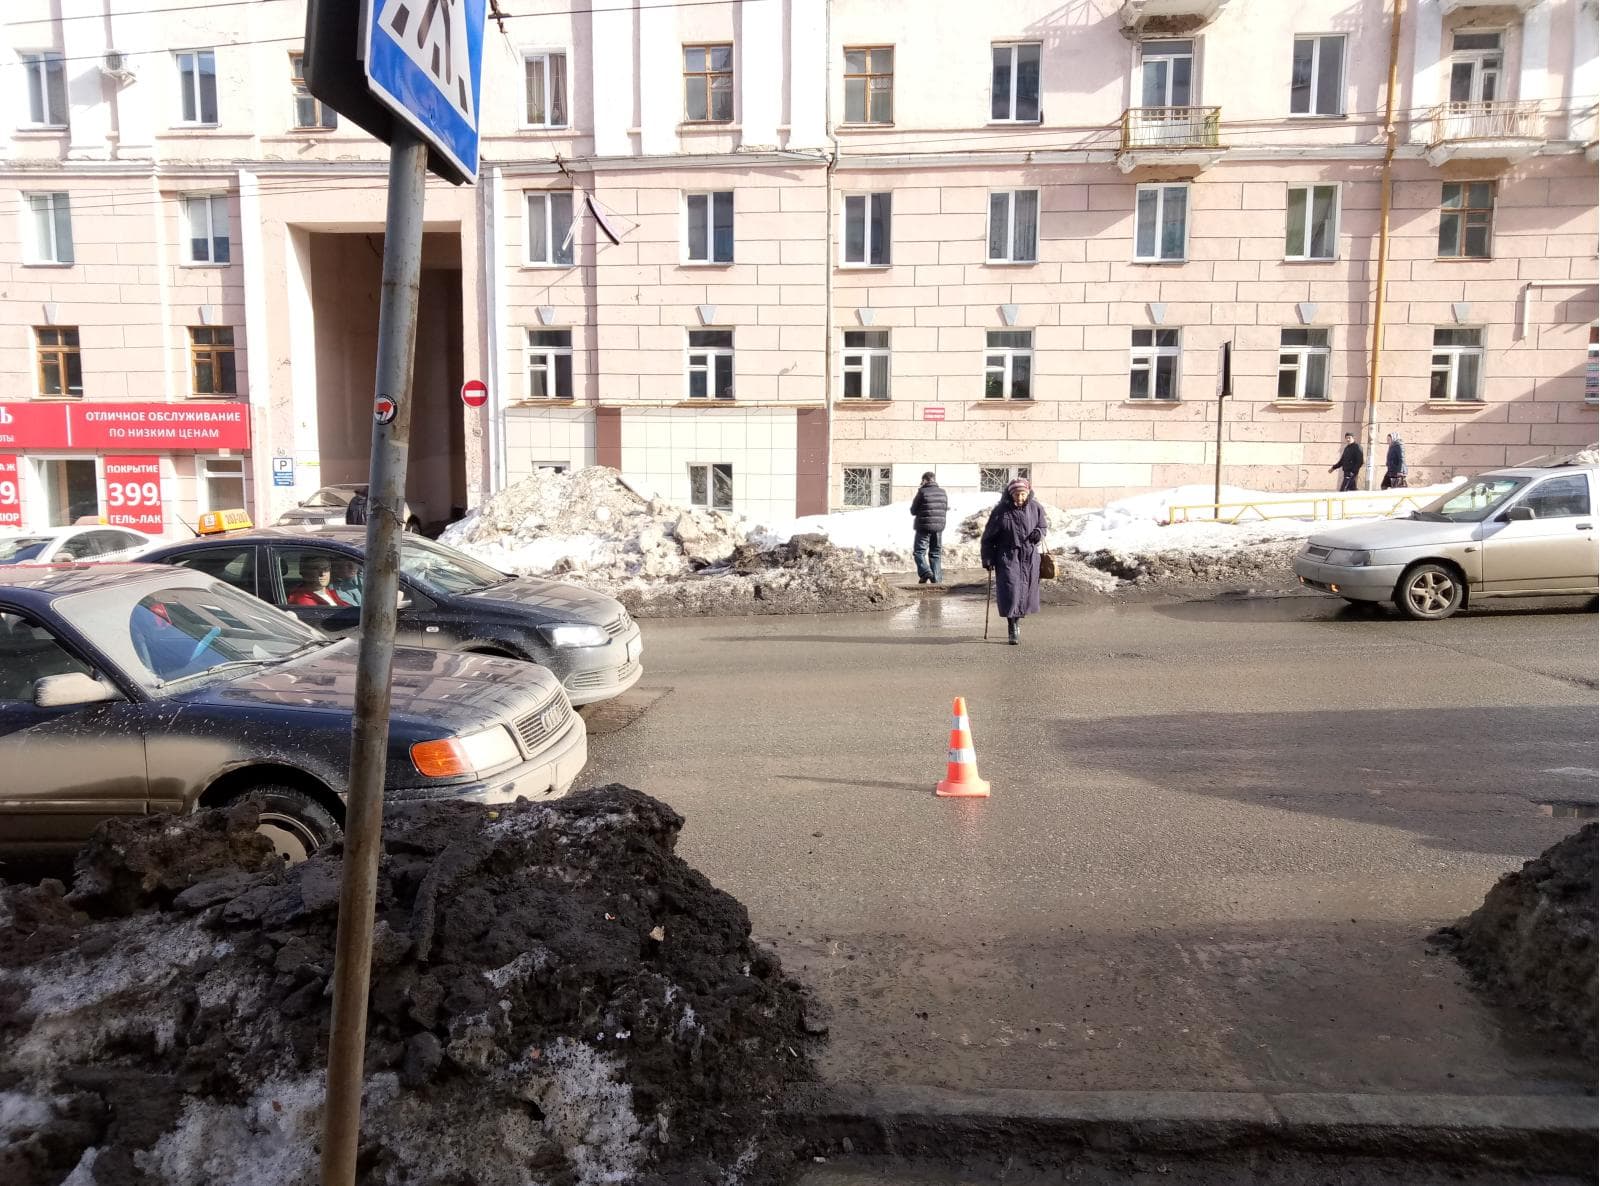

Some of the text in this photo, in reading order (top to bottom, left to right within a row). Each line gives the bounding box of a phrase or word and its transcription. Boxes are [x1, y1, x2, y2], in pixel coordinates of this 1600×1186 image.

[85, 411, 241, 422] ОТЛИЧНОЕ ОБСЛУЖИВАНИЕ
[109, 428, 219, 439] ПО НИЗКИМ ЦЕНАМ
[106, 464, 159, 473] ПОКРЫТИЕ
[110, 514, 162, 524] ГЕЛЬ-ЛАК
